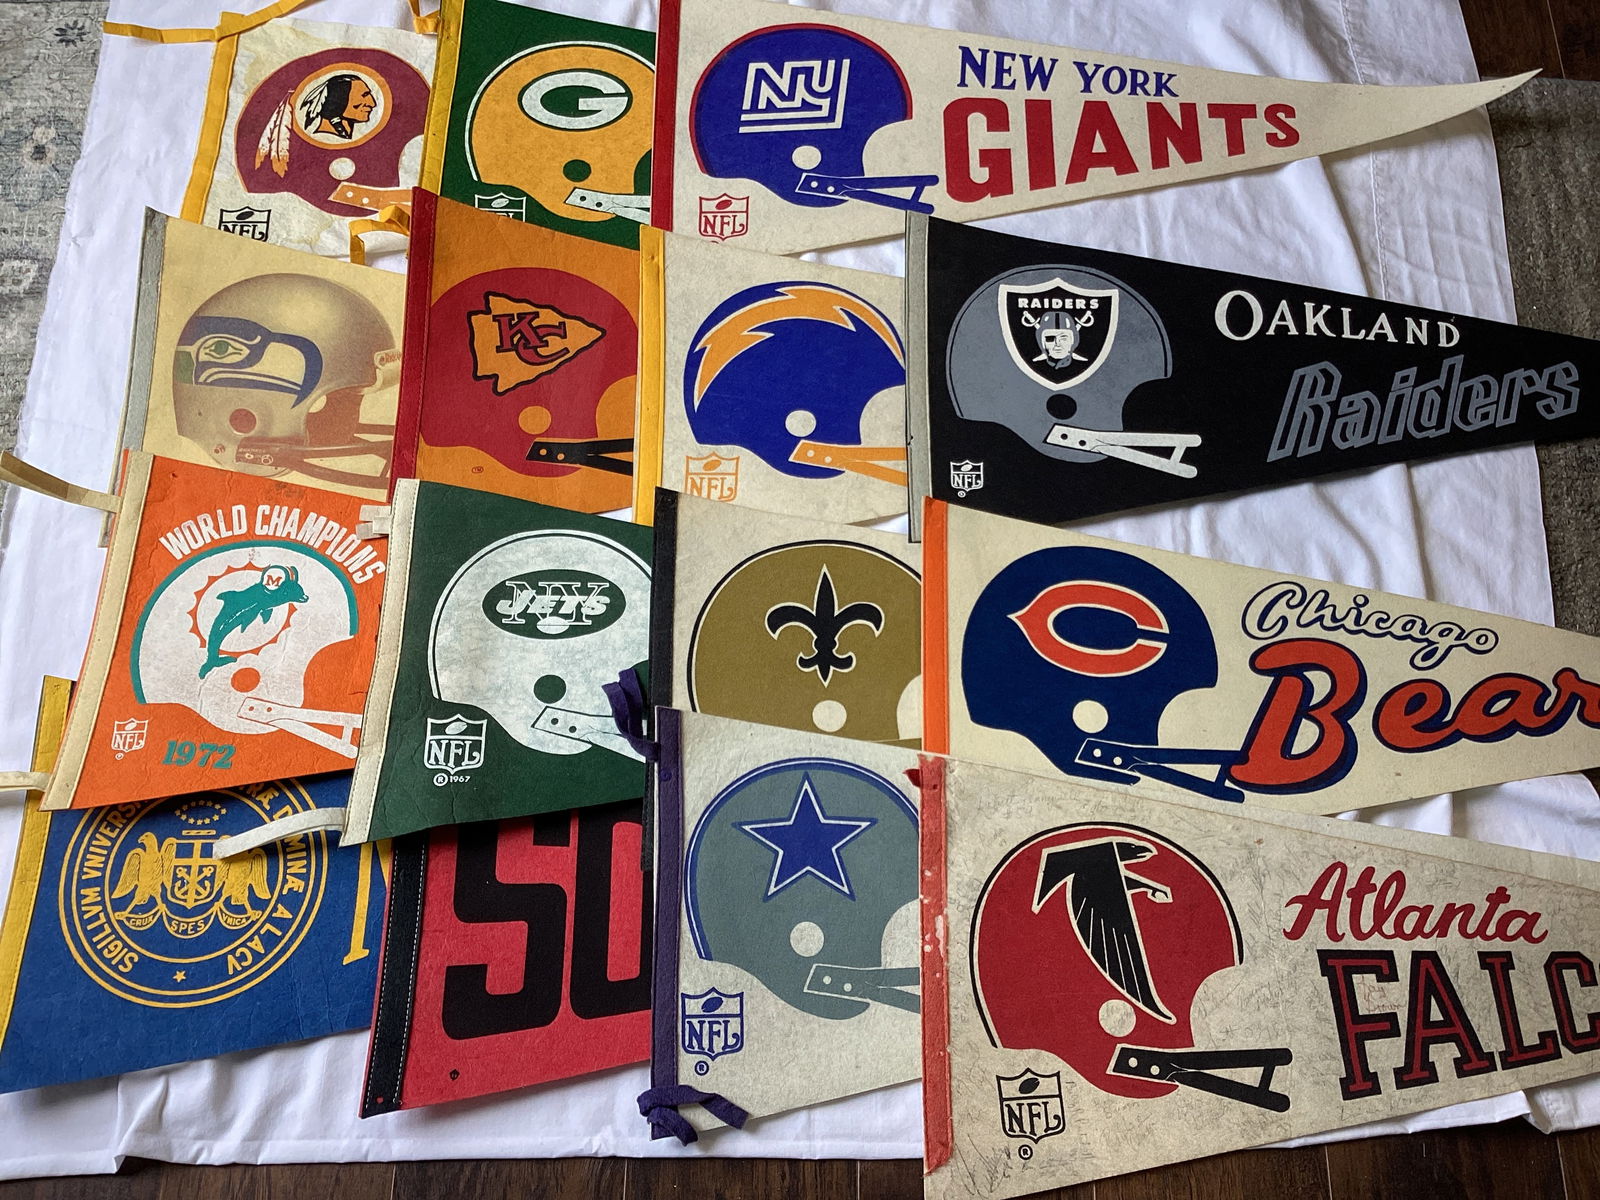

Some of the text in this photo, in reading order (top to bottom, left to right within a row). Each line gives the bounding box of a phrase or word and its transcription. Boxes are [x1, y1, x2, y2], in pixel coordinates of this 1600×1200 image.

[957, 45, 1179, 98] NEW YORK
[521, 71, 629, 129] G
[943, 97, 1300, 203] GIANTS
[702, 214, 746, 236] NFL
[1018, 297, 1099, 310] RAIDERS
[1215, 290, 1460, 347] OAKLAND
[492, 311, 571, 366] KC
[1266, 354, 1580, 463] Raiders
[690, 476, 734, 500] NFL
[953, 474, 981, 489] NFL
[159, 504, 386, 584] WORLD CHAMPIONS
[265, 574, 282, 587] M
[496, 589, 610, 616] JETS
[1241, 581, 1499, 671] Chicago
[1226, 638, 1600, 795] Bear
[112, 733, 144, 751] NFL
[161, 740, 237, 769] 1972
[428, 740, 481, 769] NFL
[1282, 861, 1549, 944] Atlanta
[129, 916, 153, 927] CRUX
[170, 919, 206, 934] SPES
[687, 1019, 741, 1051] NFL
[1317, 949, 1600, 1101] FALC
[1005, 1101, 1062, 1137] NFL
